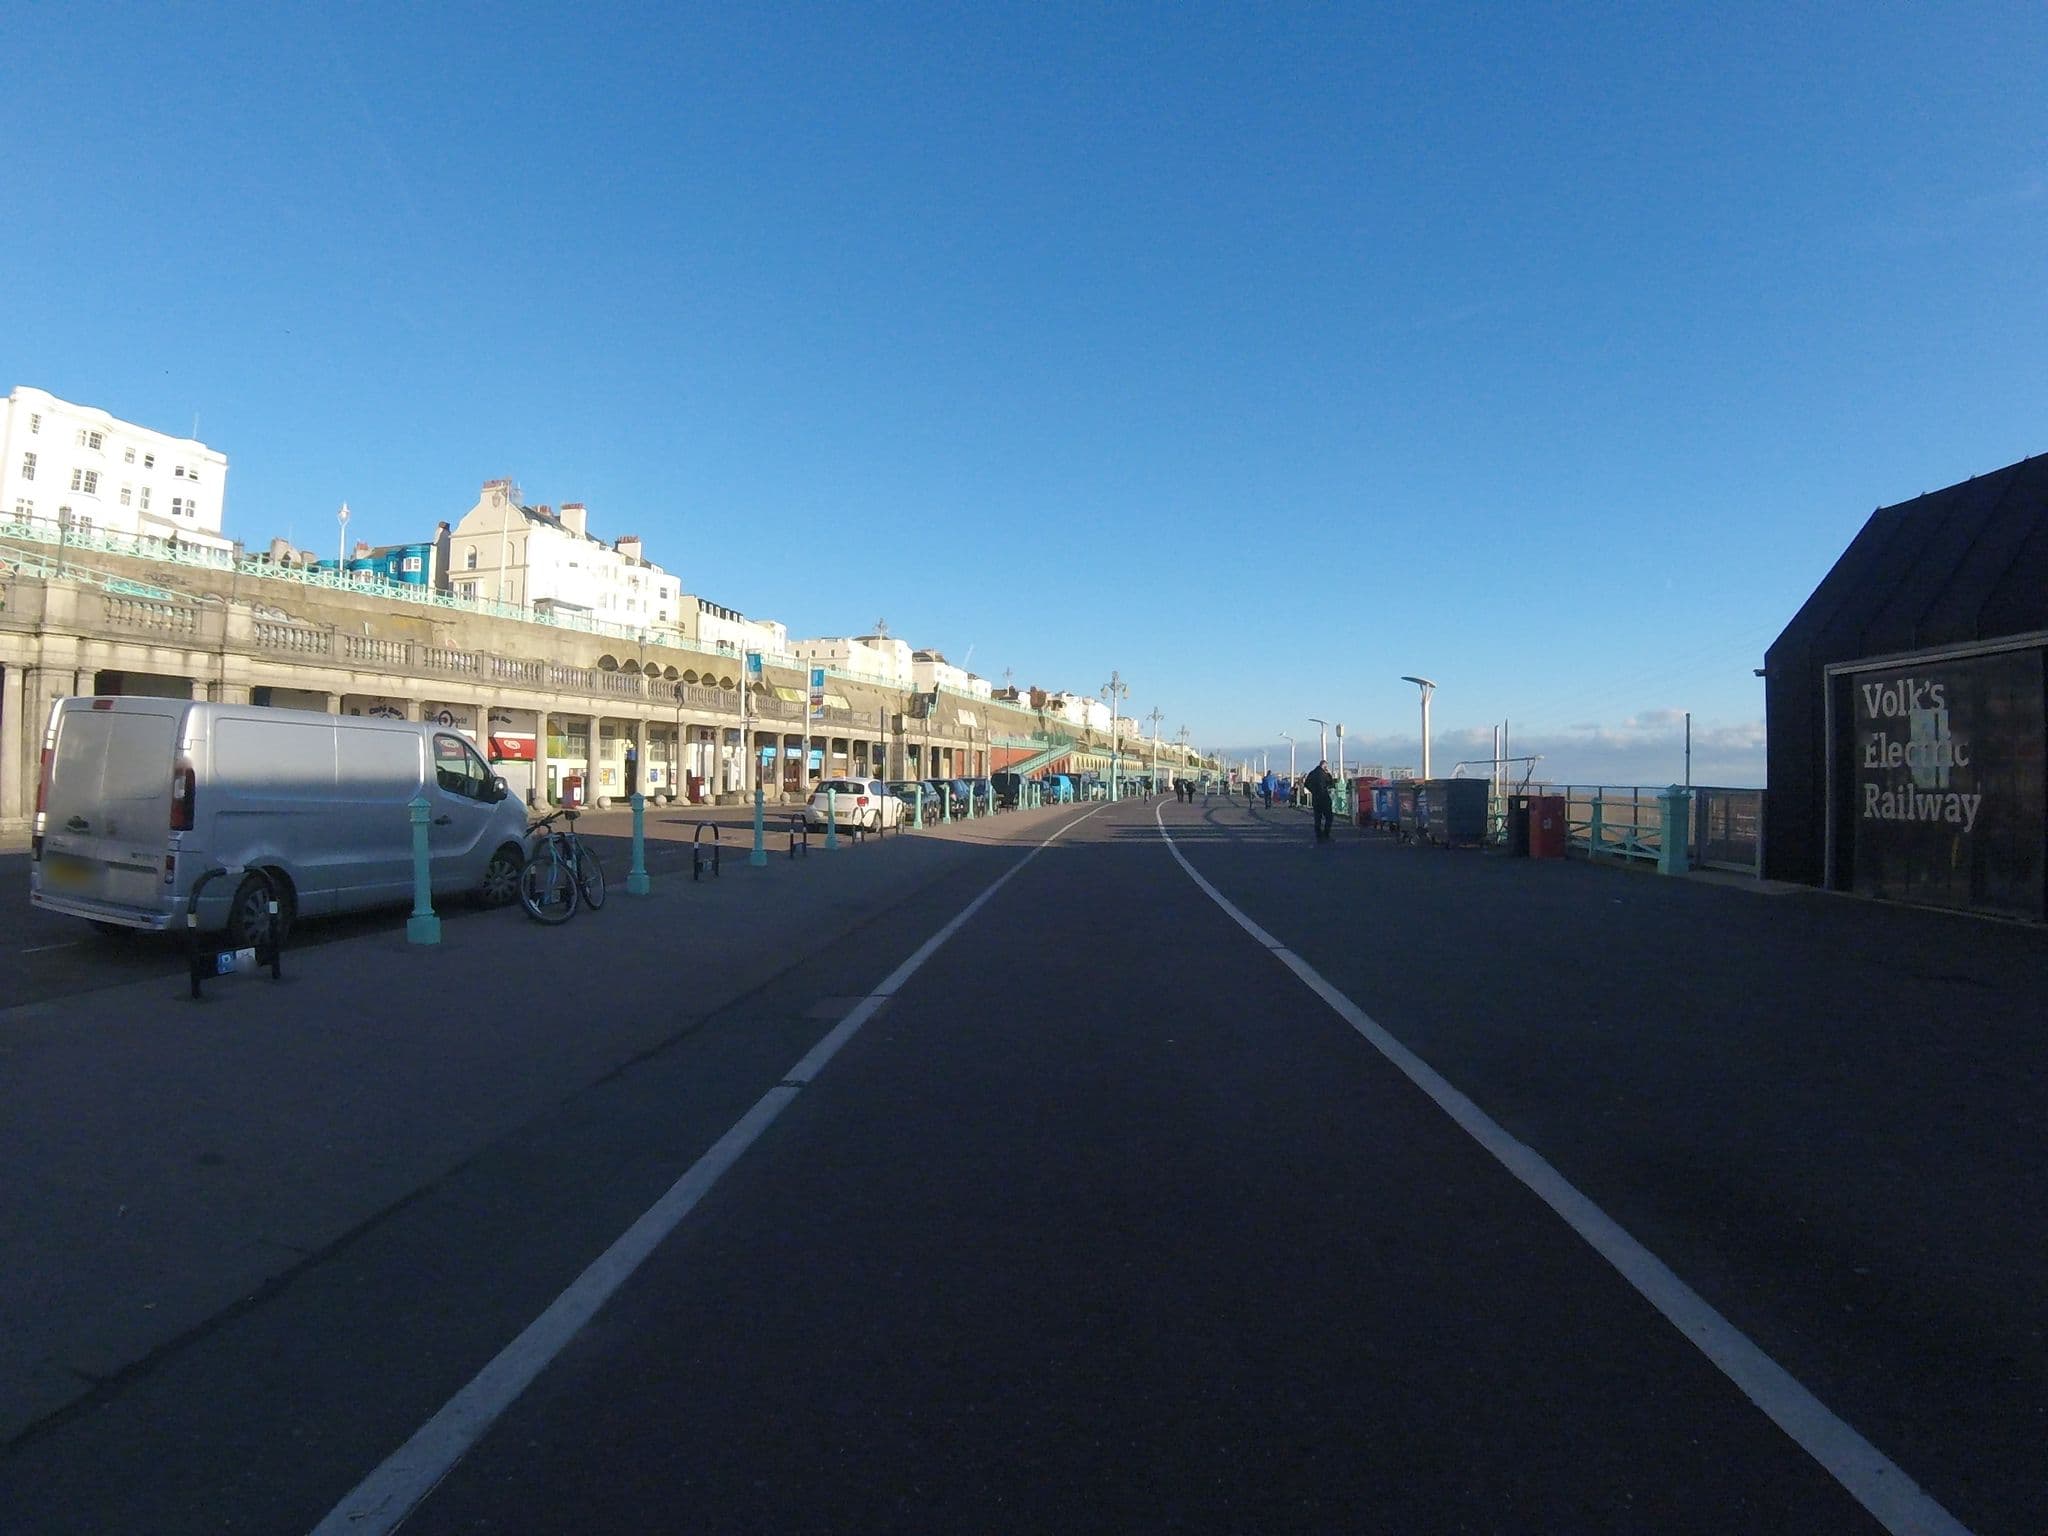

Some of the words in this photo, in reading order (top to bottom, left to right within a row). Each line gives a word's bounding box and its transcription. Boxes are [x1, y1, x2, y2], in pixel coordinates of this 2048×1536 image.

[1862, 678, 1945, 719] Volk's
[1863, 732, 1970, 768] Electric
[1863, 783, 1982, 833] Railway
